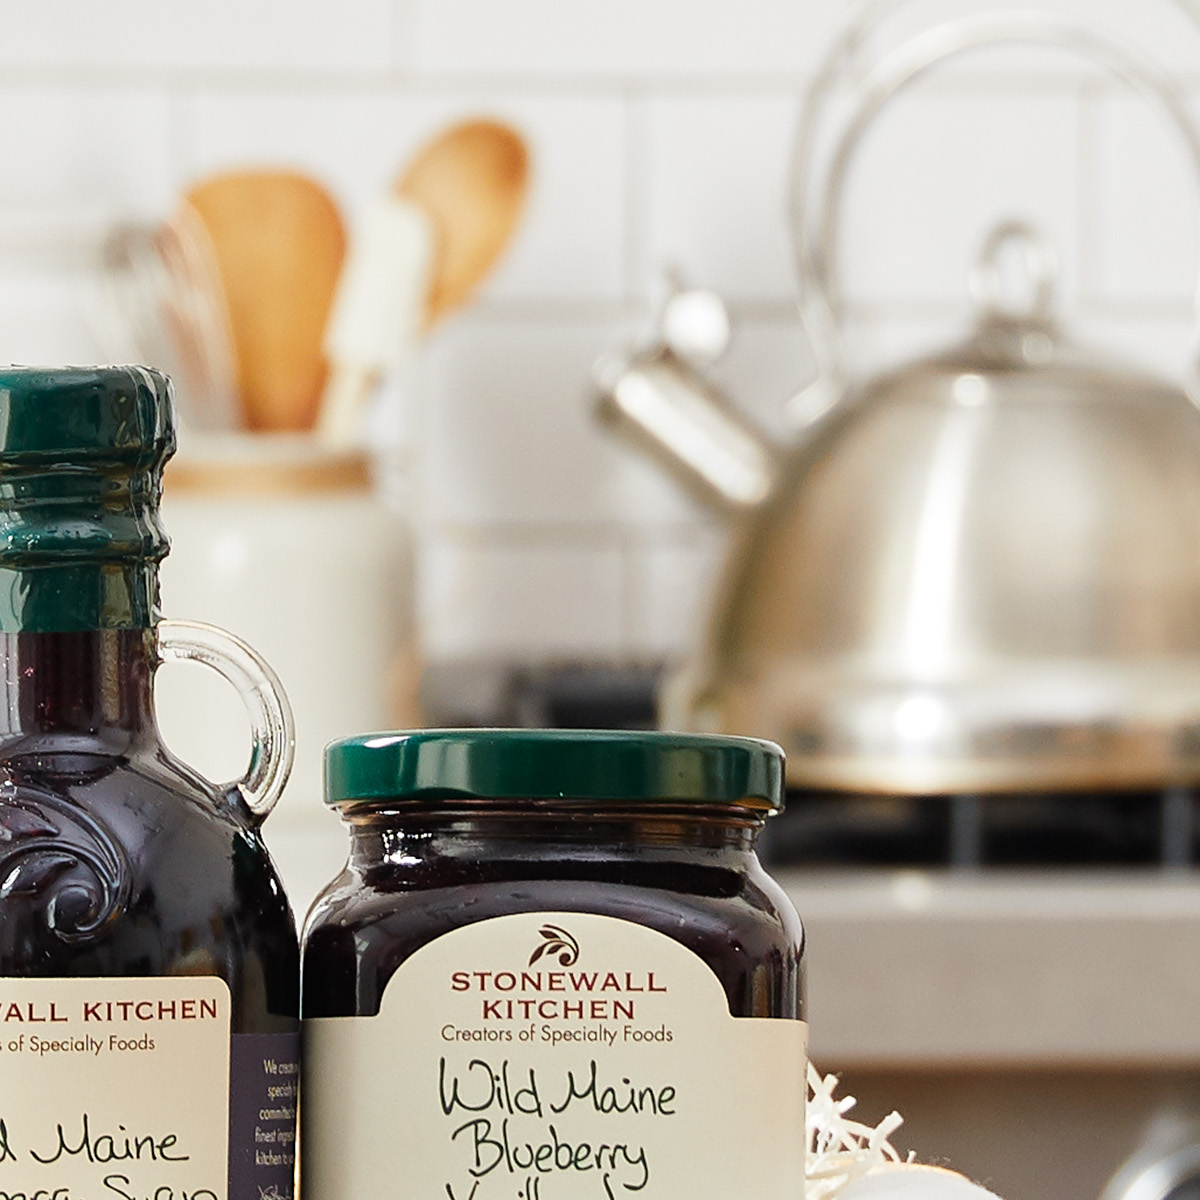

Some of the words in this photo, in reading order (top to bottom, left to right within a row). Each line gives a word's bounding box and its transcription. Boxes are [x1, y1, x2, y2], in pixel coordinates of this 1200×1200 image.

[451, 972, 668, 992] STONEWALL
[83, 999, 218, 1021] KITCHEN
[482, 1000, 635, 1020] KITCHEN
[7, 1033, 25, 1052] of
[29, 1034, 103, 1056] Specialty
[109, 1034, 155, 1051] Foods
[440, 1024, 513, 1042] Creators
[518, 1024, 536, 1042] of
[541, 1024, 617, 1046] Specialty
[624, 1024, 673, 1042] Foods
[438, 1057, 541, 1116] Wild
[551, 1060, 676, 1115] Maine
[30, 1113, 189, 1163] Maine
[451, 1118, 648, 1190] Blueberry
